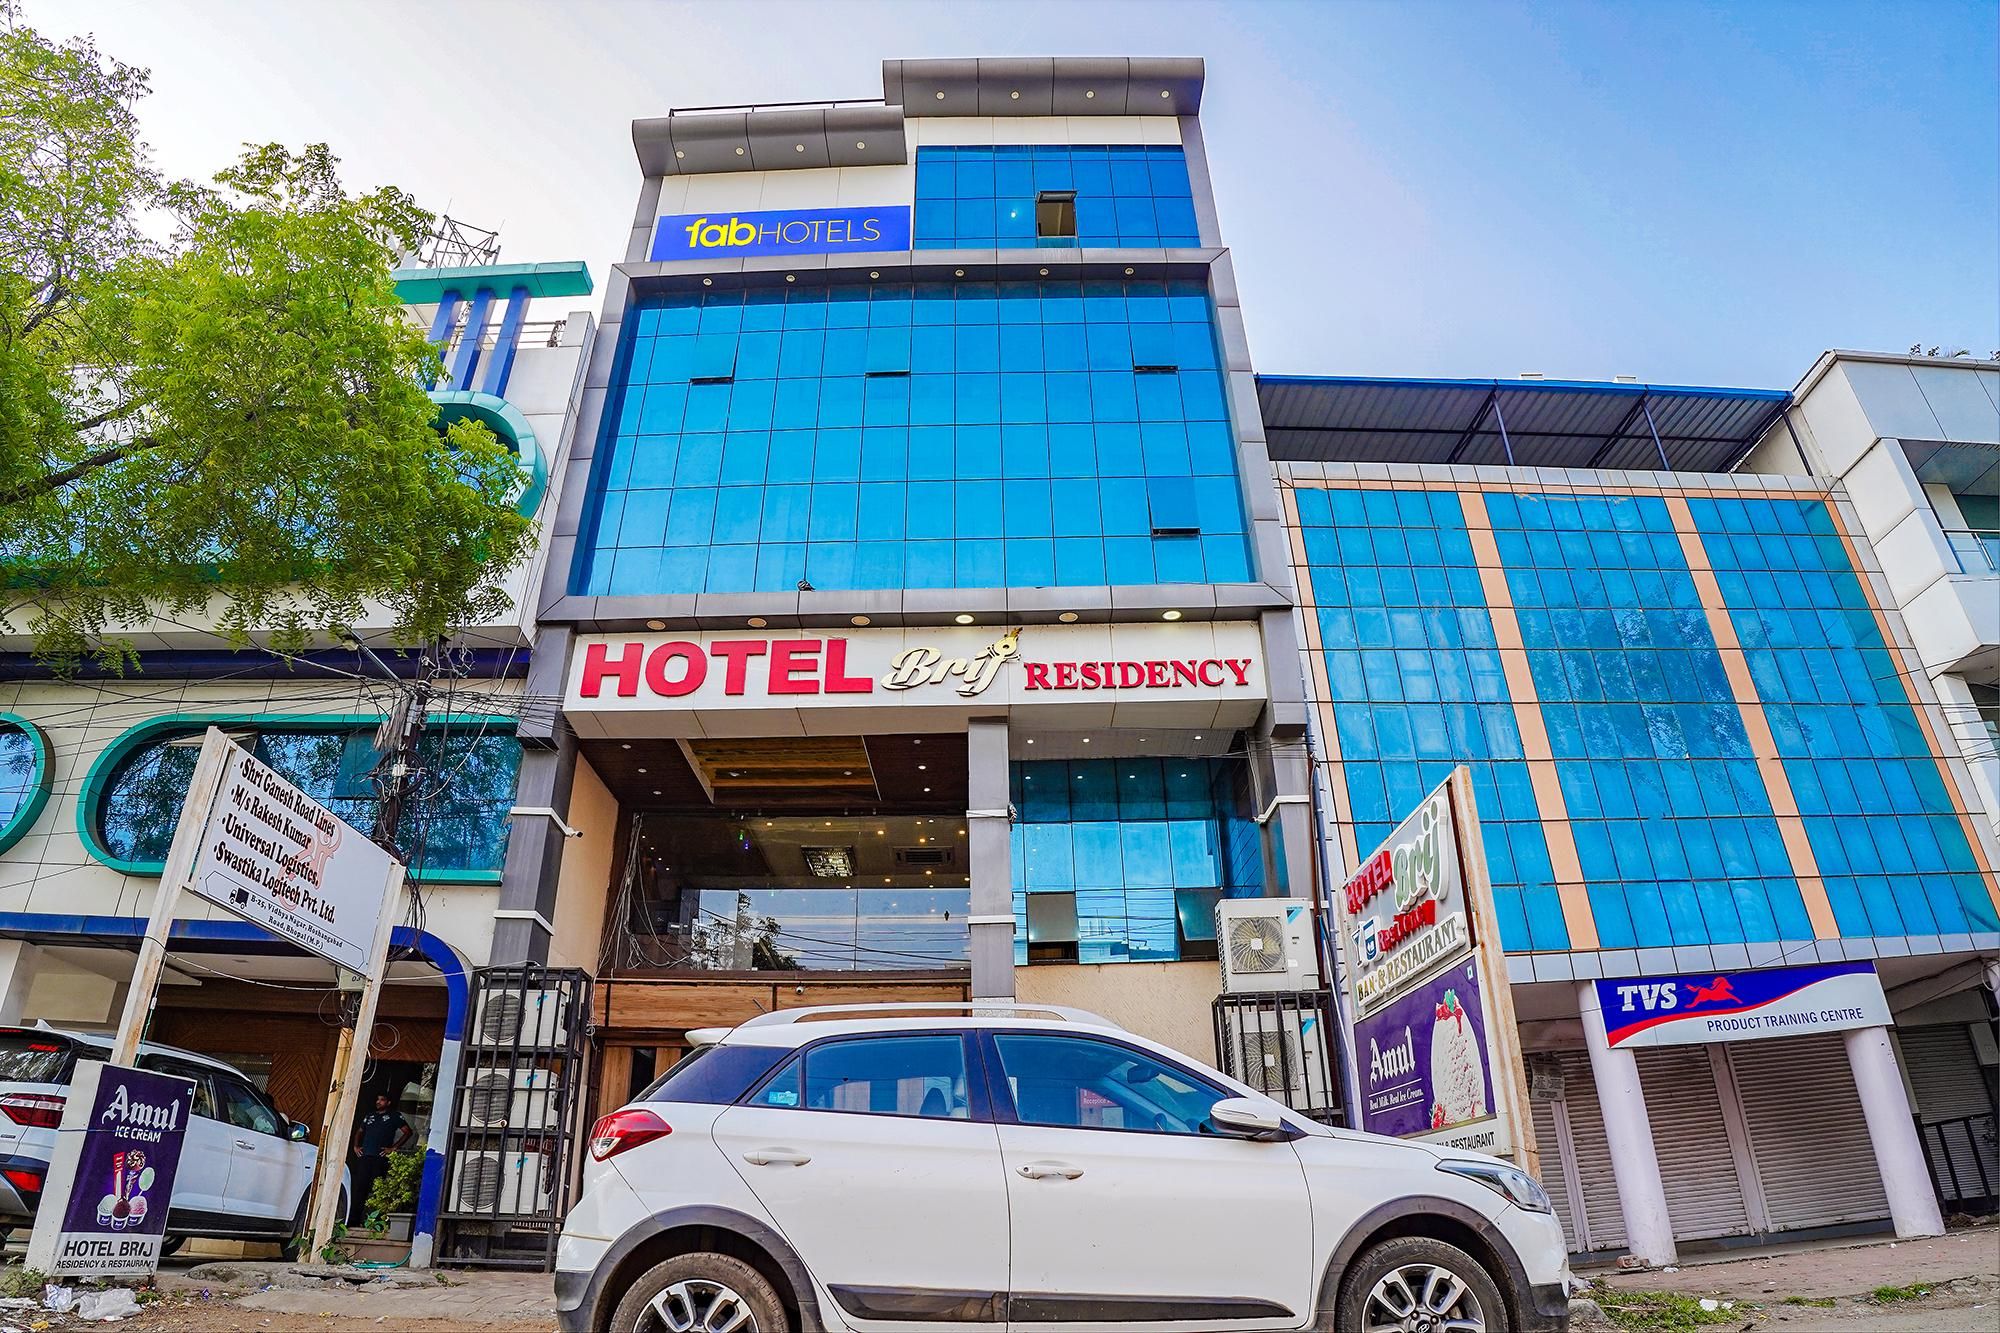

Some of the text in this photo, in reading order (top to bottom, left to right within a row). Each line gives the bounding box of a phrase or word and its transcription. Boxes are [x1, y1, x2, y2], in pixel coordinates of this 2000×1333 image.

[580, 634, 1252, 698] HOTEL Brij RESIDENCY
[234, 784, 312, 851] M/s Rakesh Kumar
[241, 757, 336, 837] Shri Ganesh Road Lines
[225, 813, 319, 887] Universal Logistics.
[1344, 797, 1446, 914] HOTEL Brij
[215, 841, 335, 924] Swastika Logitech Pvt. Ltd.
[268, 915, 286, 931] Road,
[286, 925, 306, 941] Bhopal
[307, 924, 343, 948] Hoshangabad
[1385, 916, 1457, 983] RESTAURANT
[1617, 982, 1678, 1012] TVS
[1707, 1007, 1864, 1032] PRODUCT TRAINING CENTRE
[1369, 1025, 1416, 1090] Amul
[101, 1084, 180, 1131] Amul
[114, 1125, 162, 1143] ICE CREAM
[56, 1259, 155, 1269] RESIDENCY & RESTAURANT
[63, 1240, 154, 1257] HOTEL BRIJ
